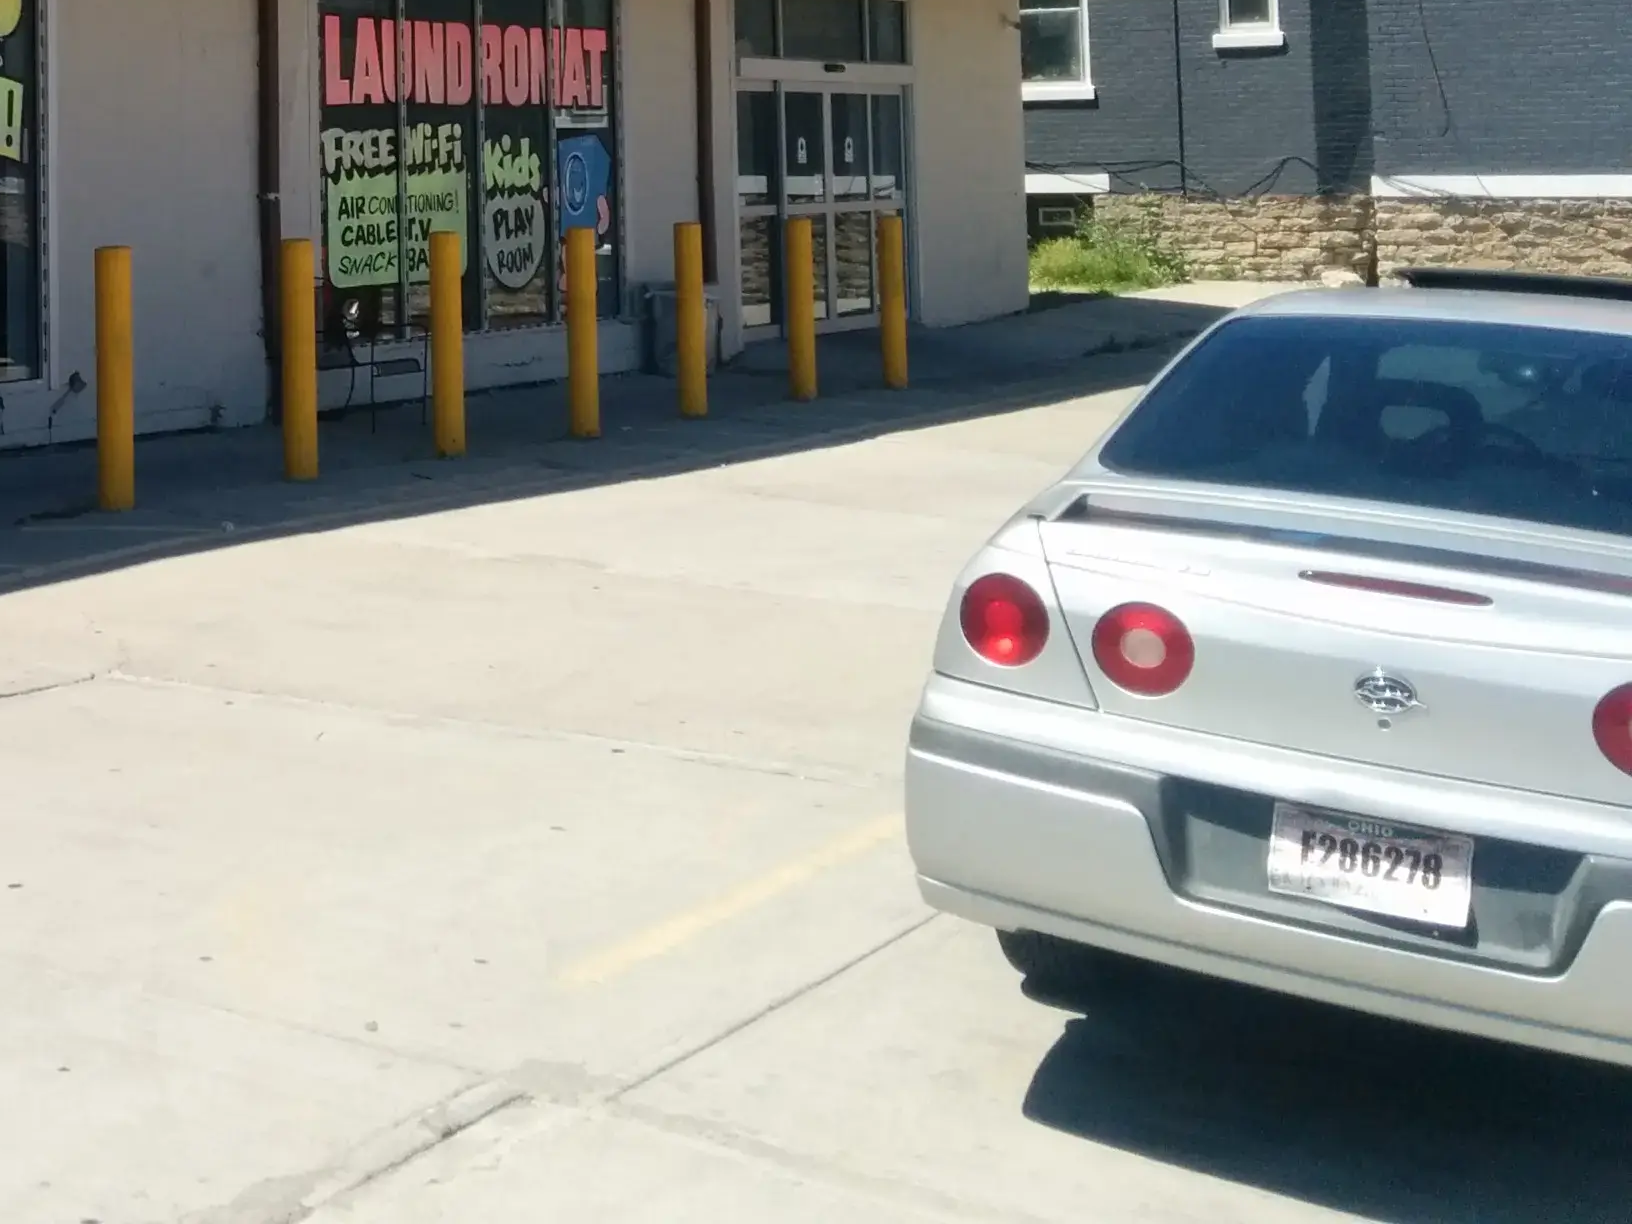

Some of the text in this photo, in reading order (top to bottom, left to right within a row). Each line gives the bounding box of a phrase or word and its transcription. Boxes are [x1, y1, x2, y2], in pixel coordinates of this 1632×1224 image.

[324, 15, 607, 107] LAUNDROMAT
[321, 123, 462, 174] FREE Wi-Fi
[484, 134, 541, 192] Kids
[338, 188, 460, 221] AIR CONTIONING!
[341, 220, 397, 247] CABLE
[492, 205, 534, 241] PLAY
[338, 248, 430, 276] SNACK BA
[497, 242, 534, 274] ROOM
[1347, 818, 1394, 837] OHIO
